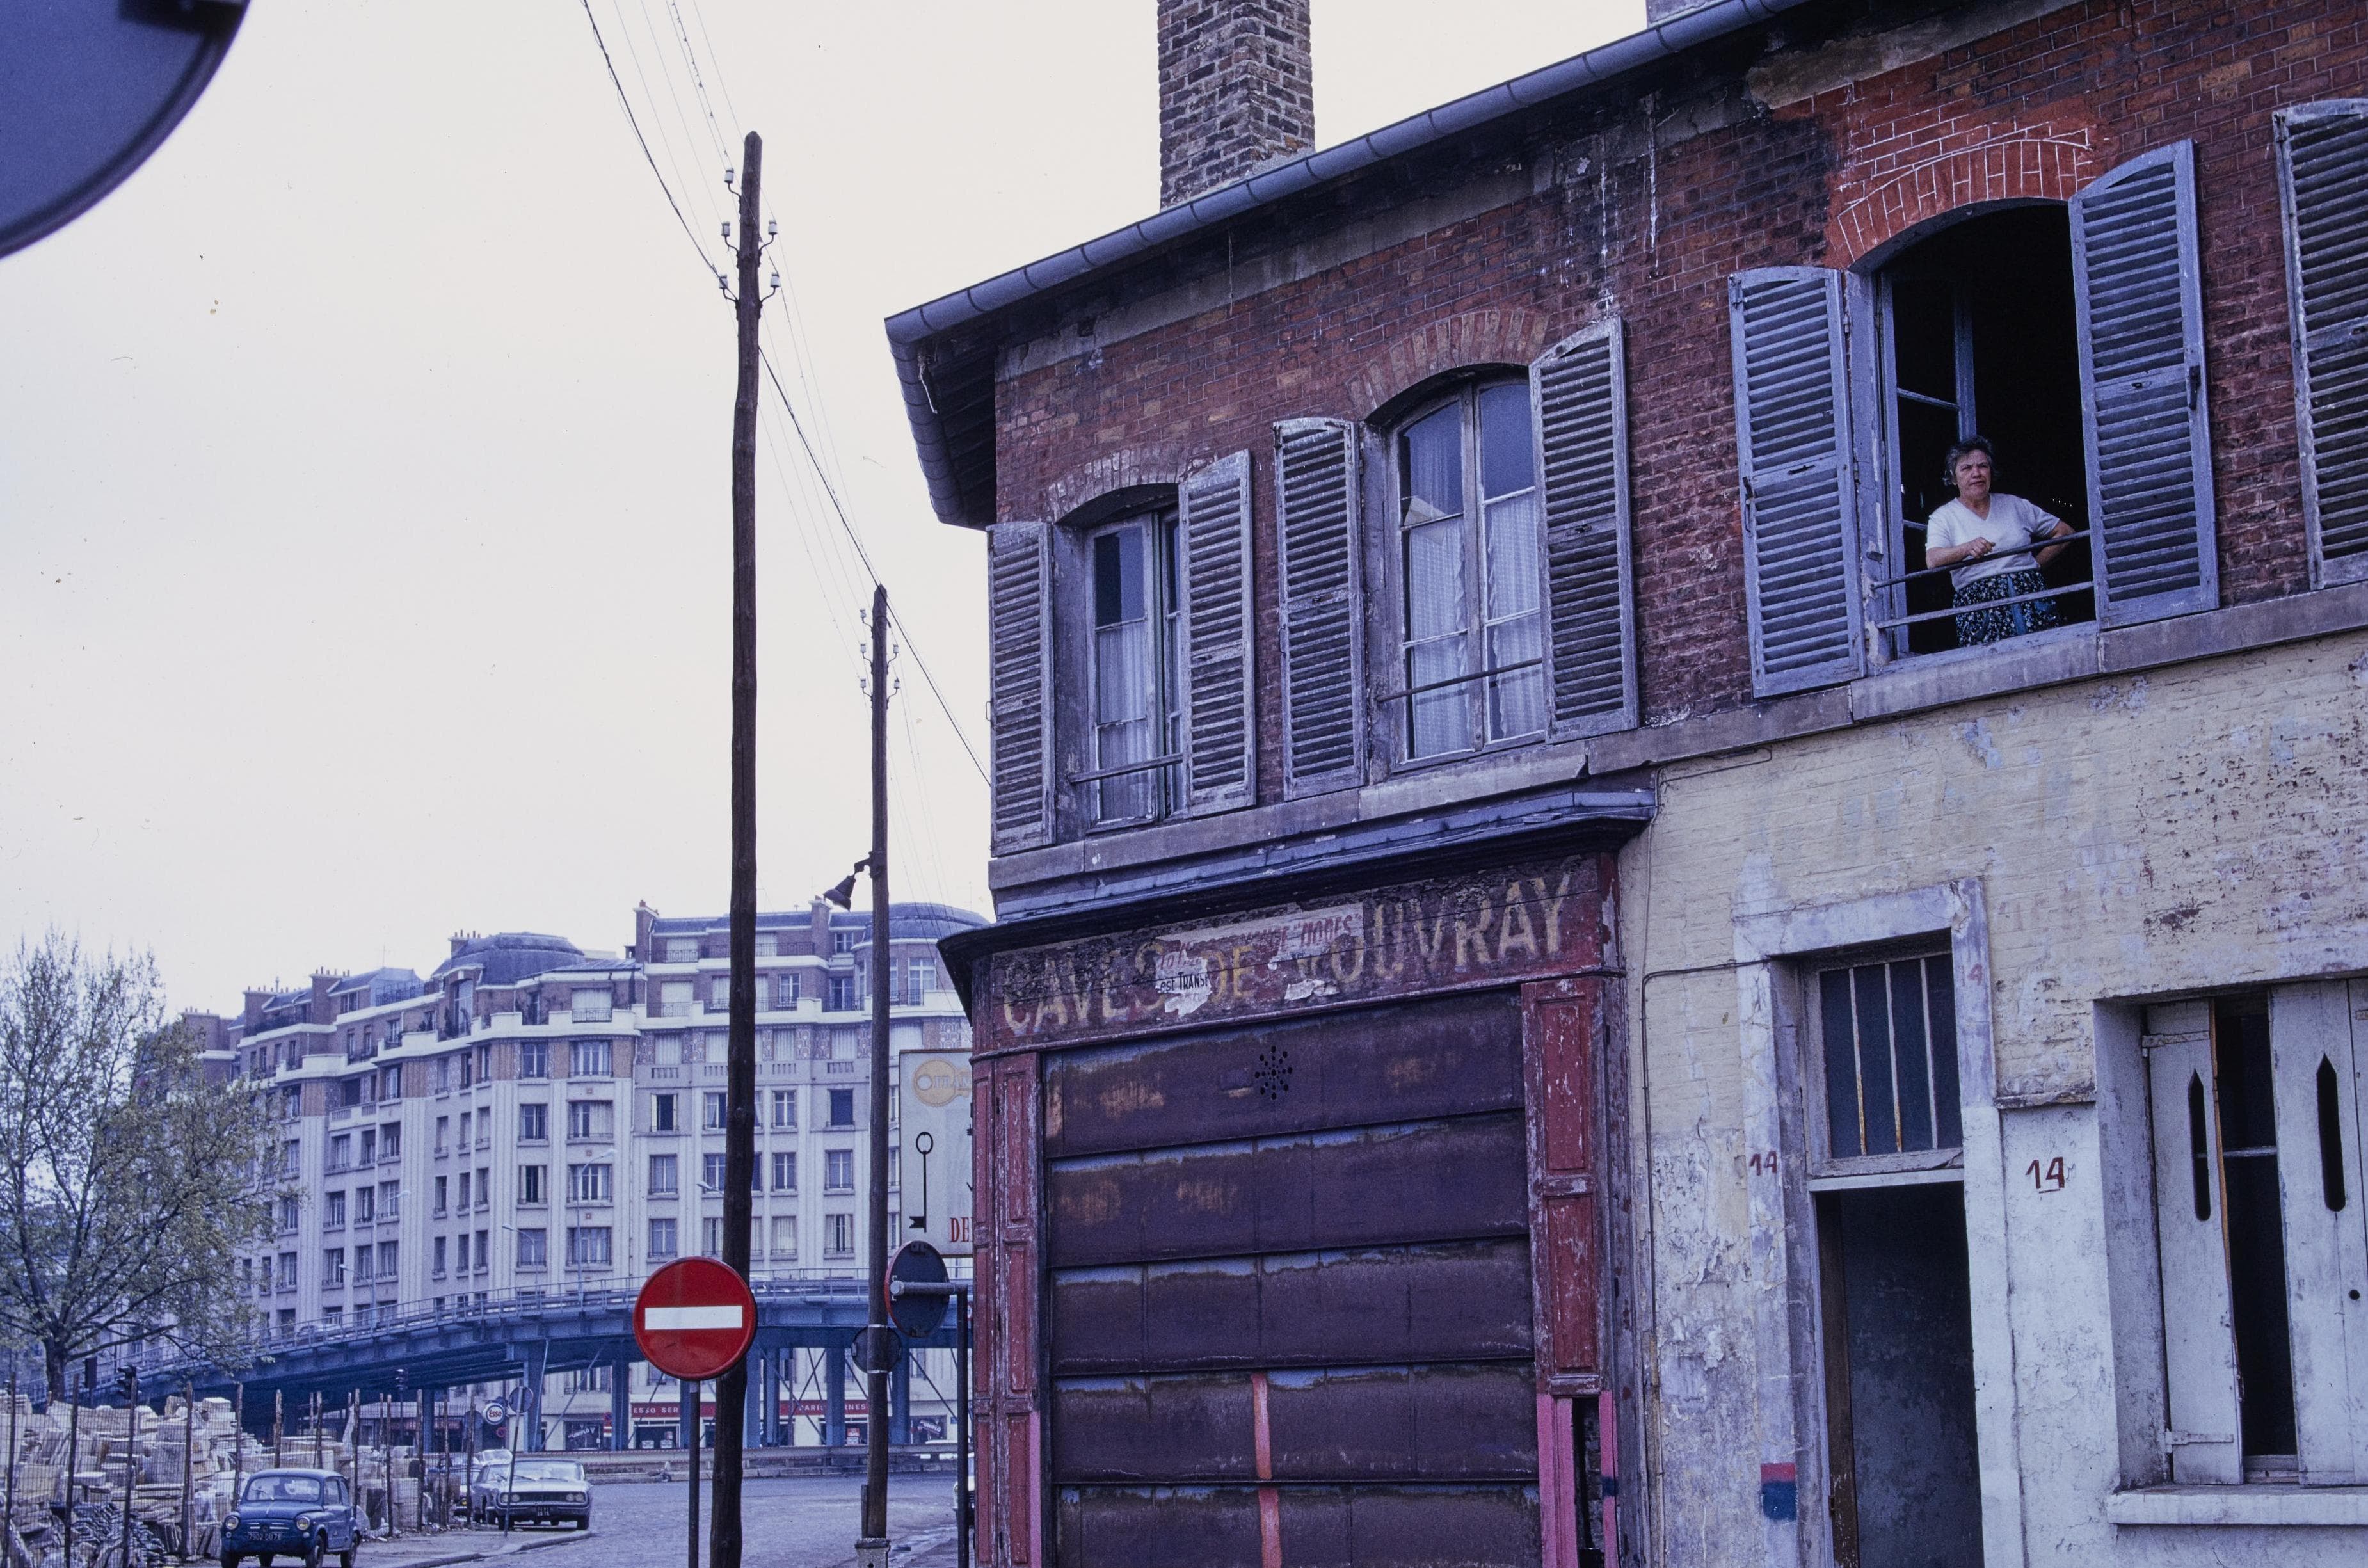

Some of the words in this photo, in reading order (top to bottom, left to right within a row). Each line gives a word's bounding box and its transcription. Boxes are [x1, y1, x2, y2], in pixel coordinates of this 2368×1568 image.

[1749, 1151, 1777, 1176] 14
[2025, 1156, 2065, 1189] 14
[950, 1217, 973, 1242] DE
[488, 1409, 502, 1418] Esso
